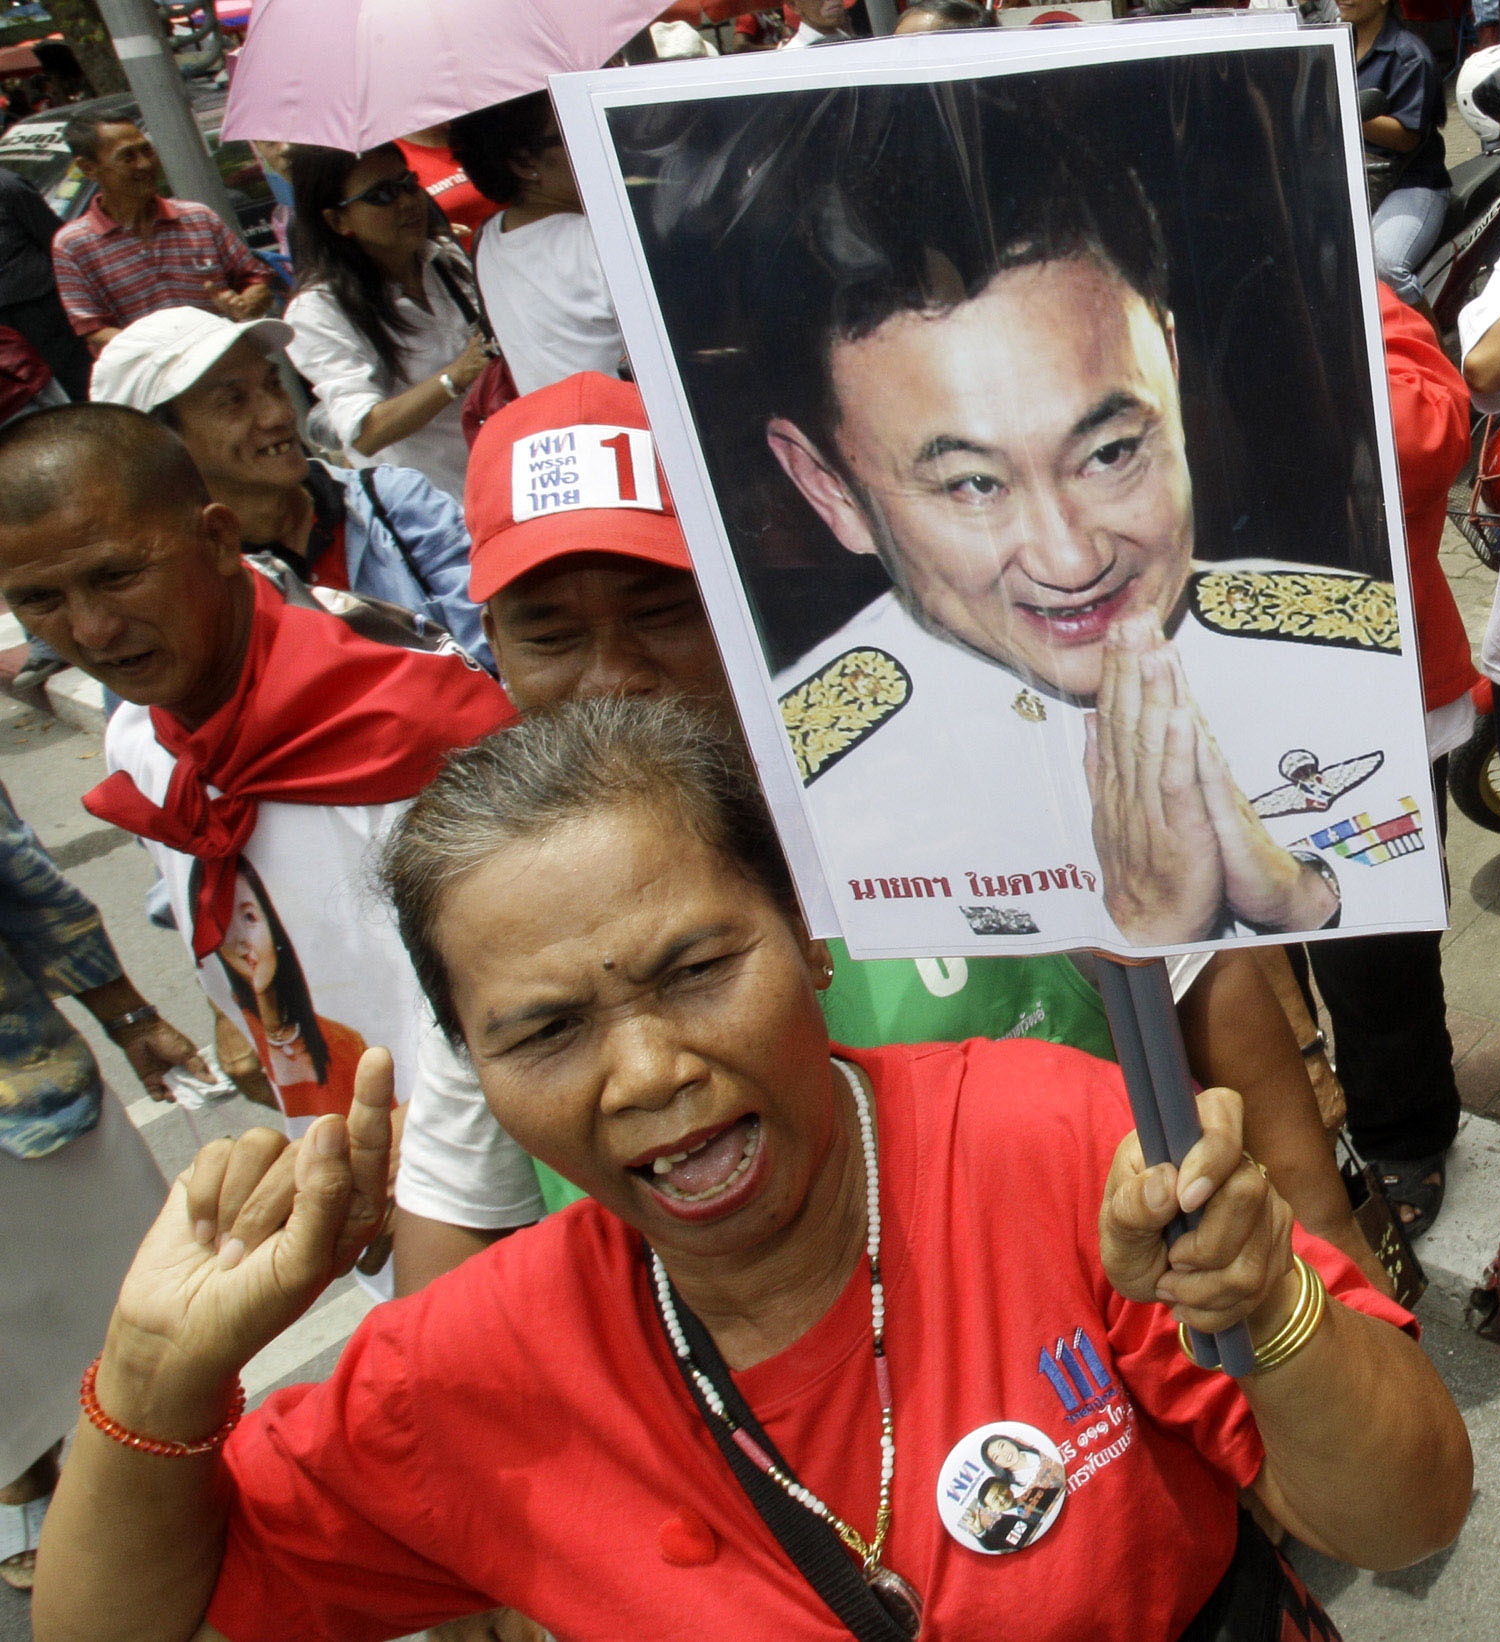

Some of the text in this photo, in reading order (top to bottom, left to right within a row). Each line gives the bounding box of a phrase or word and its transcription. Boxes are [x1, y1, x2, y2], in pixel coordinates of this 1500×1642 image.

[529, 455, 577, 472] พรรค
[600, 432, 638, 501] 1
[526, 489, 580, 511] ไทย
[848, 863, 1096, 900] นายกฯ ในดวงใจ
